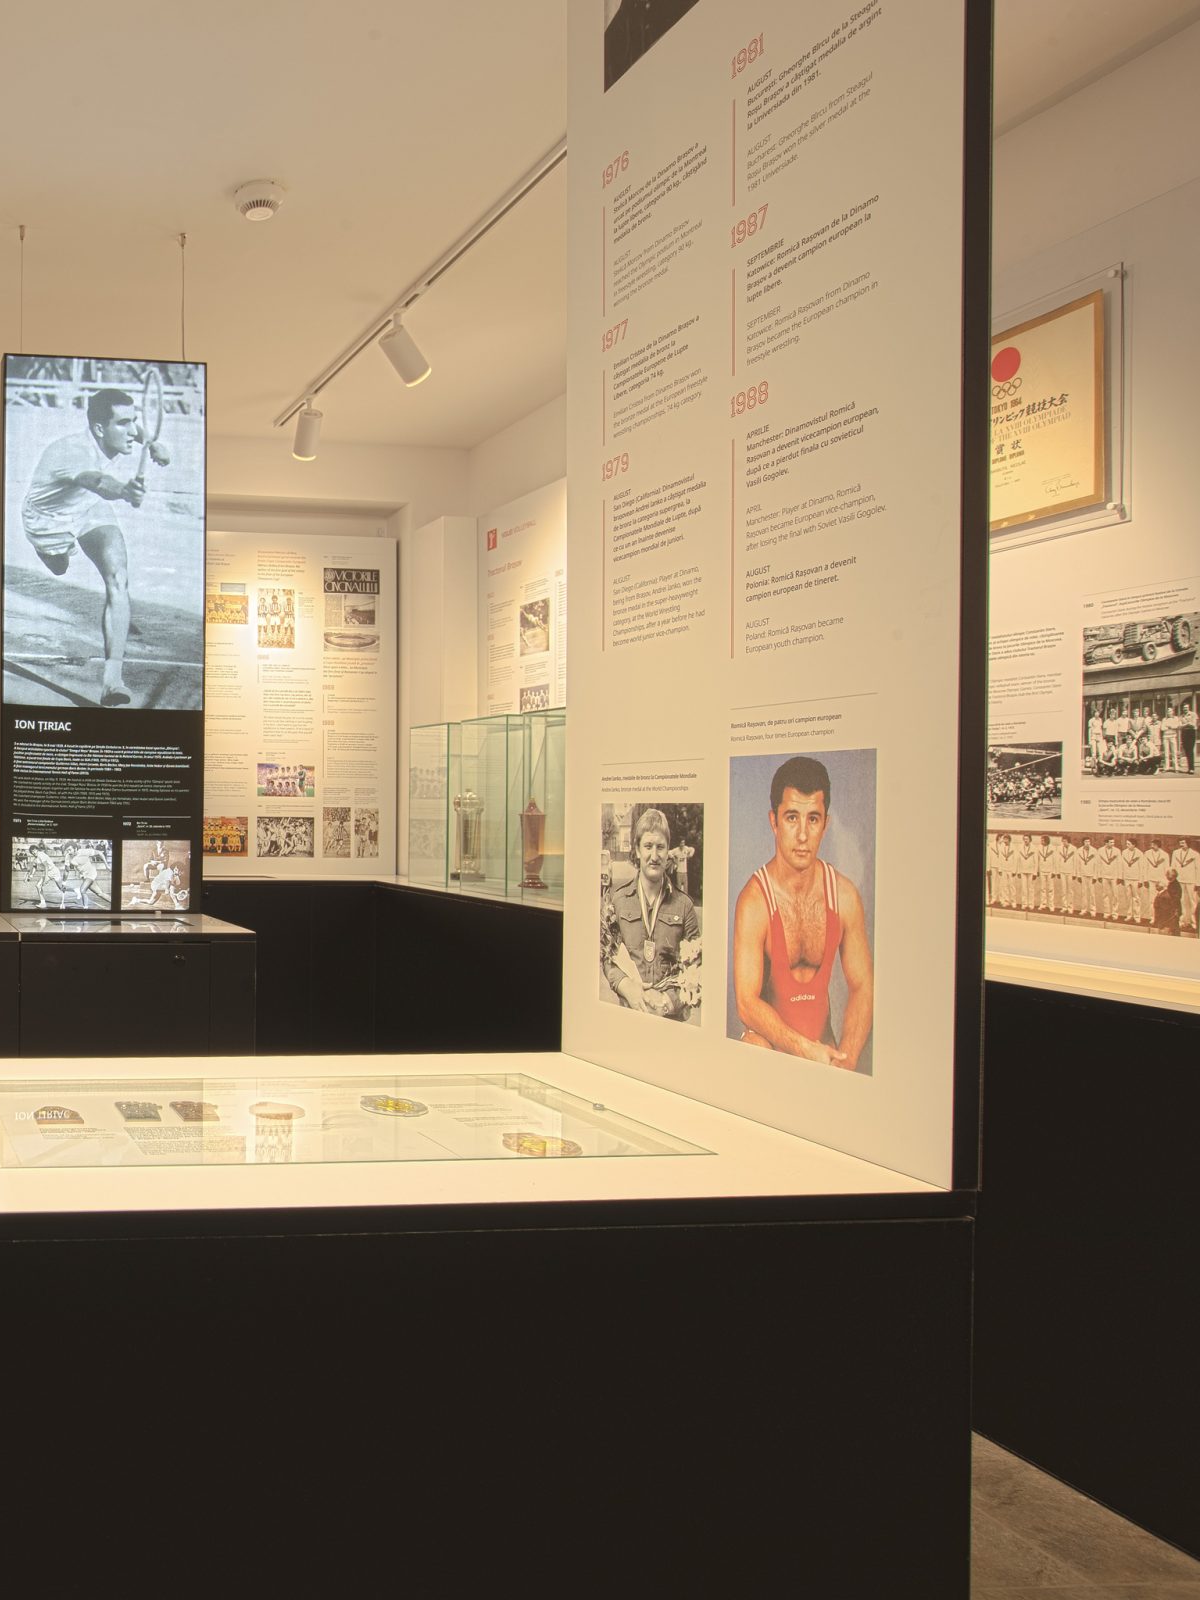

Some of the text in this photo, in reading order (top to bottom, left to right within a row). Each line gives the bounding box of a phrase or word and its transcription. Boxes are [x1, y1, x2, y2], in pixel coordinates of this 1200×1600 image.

[731, 33, 765, 79] 1981
[778, 51, 811, 81] Gheorghe
[831, 28, 840, 39] de
[842, 21, 849, 31] la
[785, 81, 790, 89] a
[818, 36, 846, 63] medalia
[847, 28, 856, 39] de
[858, 7, 882, 31] argint
[747, 68, 772, 95] AUGUST
[747, 69, 821, 131] la Universiada din 1981.
[602, 150, 630, 189] 1976
[731, 203, 769, 248] 1987
[831, 218, 840, 228] de
[841, 213, 848, 222] la
[850, 195, 879, 217] Dinamo
[747, 238, 784, 267] SEPTEMBRIE
[773, 256, 797, 276] devenit
[798, 239, 827, 261] campion
[828, 218, 863, 243] european
[864, 213, 871, 222] la
[747, 279, 783, 303] lupte libere.
[601, 318, 628, 352] 1977
[730, 381, 769, 418] 1988
[746, 424, 769, 440] APRILIE
[746, 432, 784, 452] Manchester:
[785, 412, 828, 437] Dinamovistul
[771, 447, 776, 455] a
[776, 437, 800, 452] devenit
[800, 421, 842, 443] vicecampion
[843, 407, 879, 426] european,
[762, 462, 770, 470] ce
[776, 450, 799, 467] pierdut
[800, 443, 819, 456] finala
[820, 439, 829, 448] cu
[830, 424, 864, 445] sovieticul
[601, 453, 629, 481] 1979
[762, 468, 789, 482] Gogolev.
[770, 519, 793, 532] became
[794, 510, 825, 525] European
[782, 504, 800, 516] Player
[801, 501, 808, 510] at
[746, 542, 759, 552] after
[760, 537, 777, 547] losing
[778, 533, 788, 542] the
[789, 528, 802, 538] final
[803, 524, 816, 535] with
[817, 518, 837, 531] Soviet
[856, 505, 887, 519] Gogolev.
[746, 565, 771, 578] AUGUST
[746, 579, 770, 590] Polonia:
[830, 556, 856, 569] devenit
[745, 574, 839, 603] campion european de tineret.
[745, 617, 770, 629] AUGUST
[817, 617, 844, 628] became
[746, 643, 773, 654] European
[774, 638, 791, 650] youth
[15, 719, 72, 732] ION ȚIRIAC
[795, 716, 817, 725] campion
[817, 714, 842, 723] european
